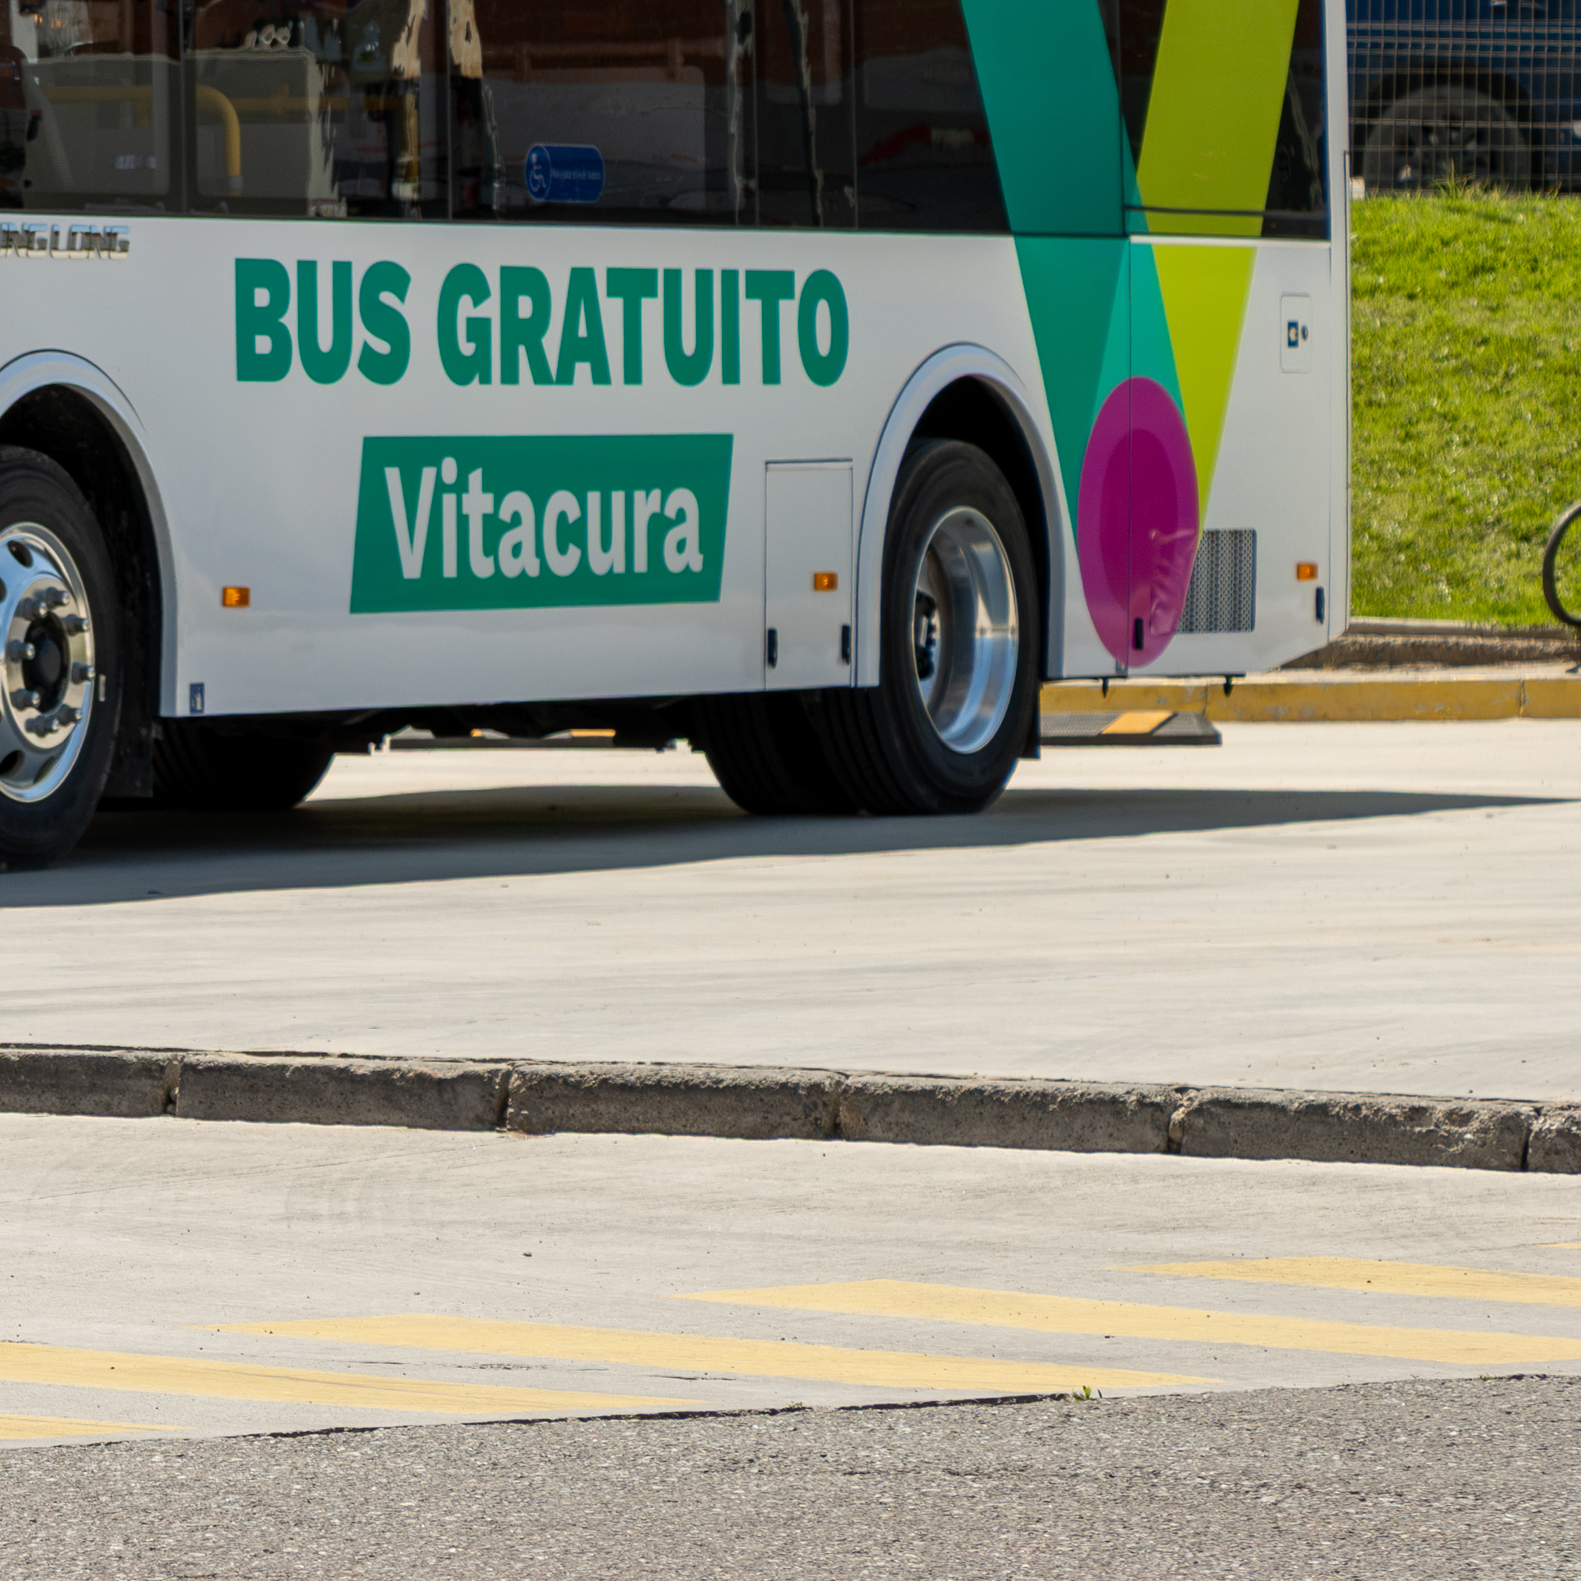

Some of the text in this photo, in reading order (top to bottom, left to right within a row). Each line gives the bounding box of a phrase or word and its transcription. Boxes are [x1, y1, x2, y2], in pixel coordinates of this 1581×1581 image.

[235, 257, 850, 388] BUS GRATUITO
[383, 456, 705, 580] Vitacura
